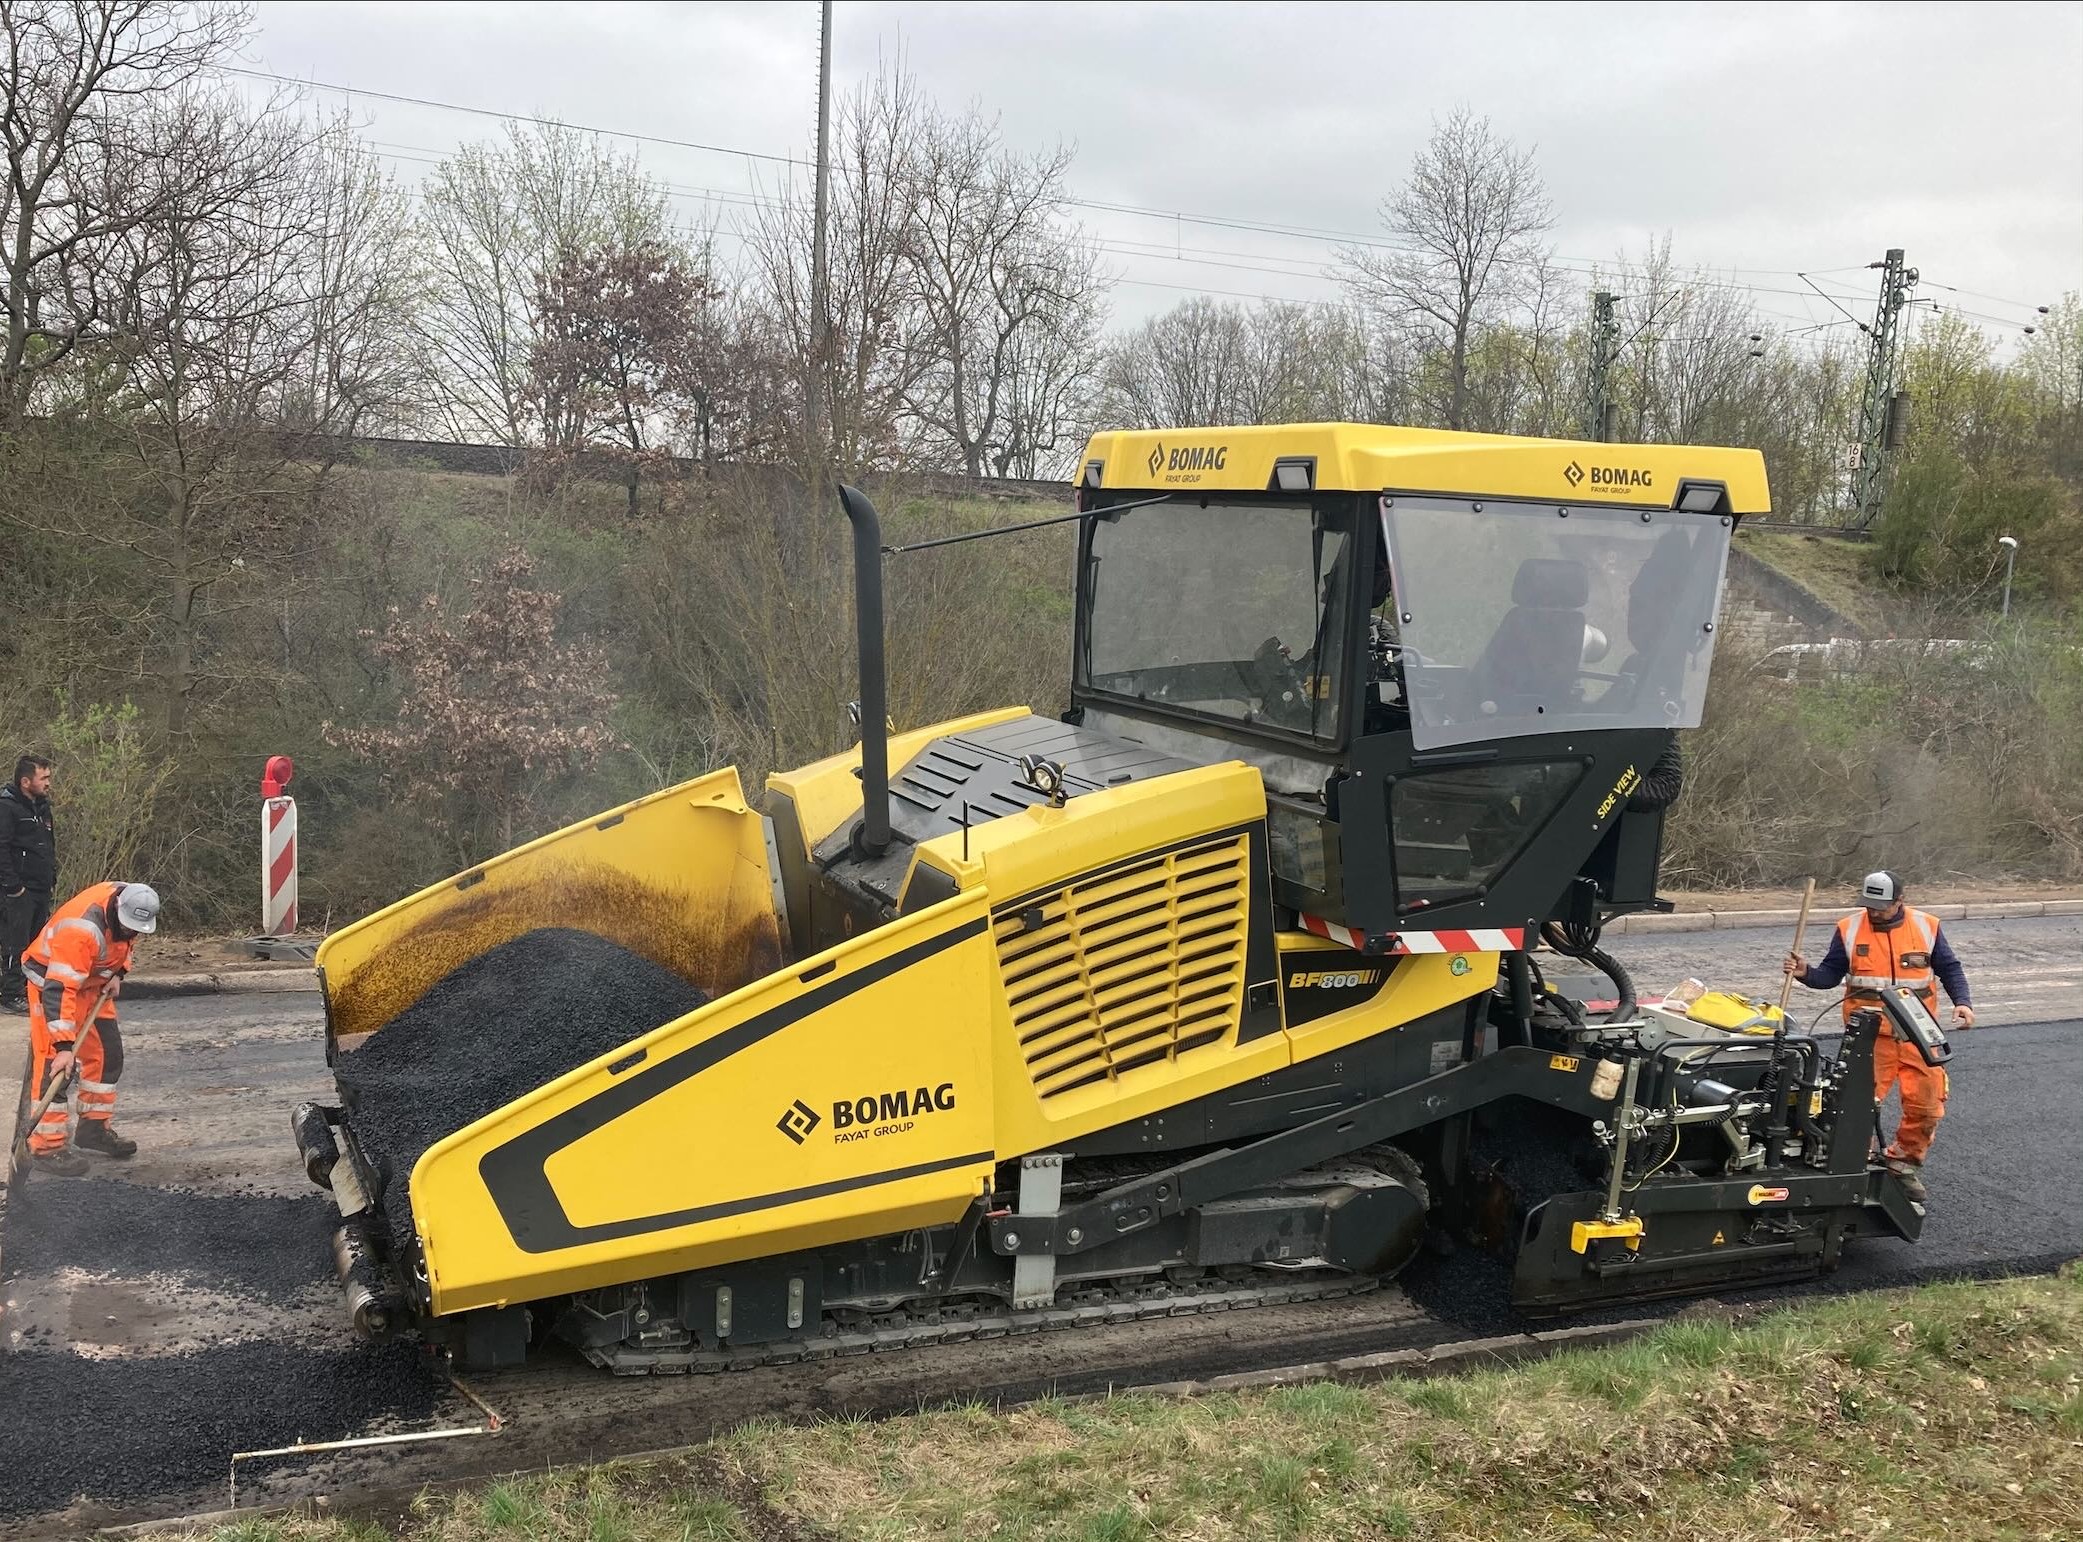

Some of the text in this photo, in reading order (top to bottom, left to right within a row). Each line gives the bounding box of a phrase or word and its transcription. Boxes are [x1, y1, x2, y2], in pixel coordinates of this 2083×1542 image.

[1168, 446, 1228, 471] BOMAG
[1849, 444, 1859, 455] 16
[1849, 456, 1855, 466] 8
[1591, 467, 1652, 487] BOMAG
[1597, 764, 1635, 819] SIDE VIEW
[833, 1083, 955, 1129] BOMAG
[834, 1121, 914, 1144] FAYAT GROUP
